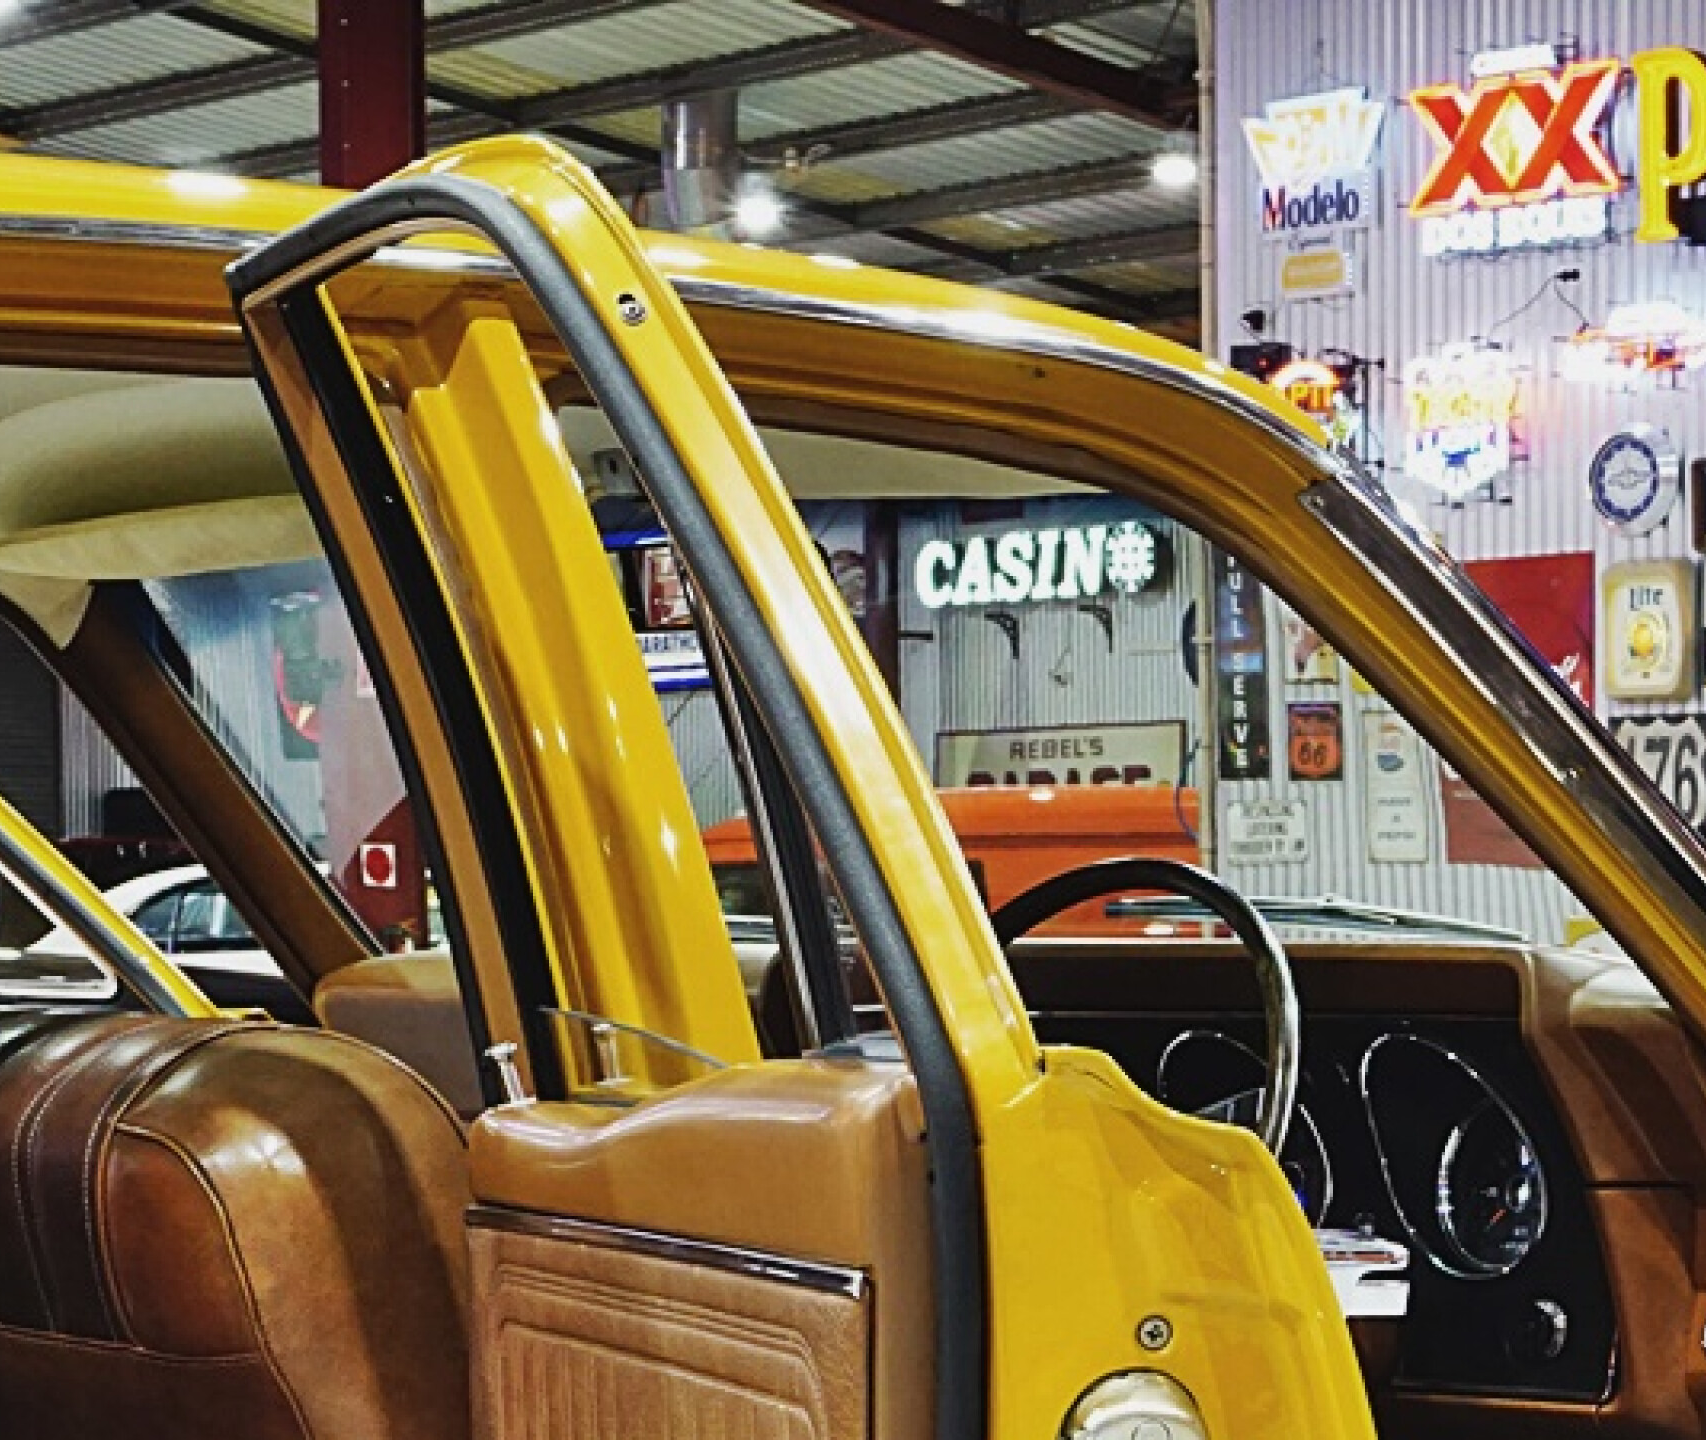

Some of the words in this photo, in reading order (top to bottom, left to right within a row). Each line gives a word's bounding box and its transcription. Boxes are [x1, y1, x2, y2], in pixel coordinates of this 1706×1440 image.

[1409, 60, 1619, 217] XX
[1261, 179, 1360, 232] Modelo
[915, 521, 1155, 609] CASINO
